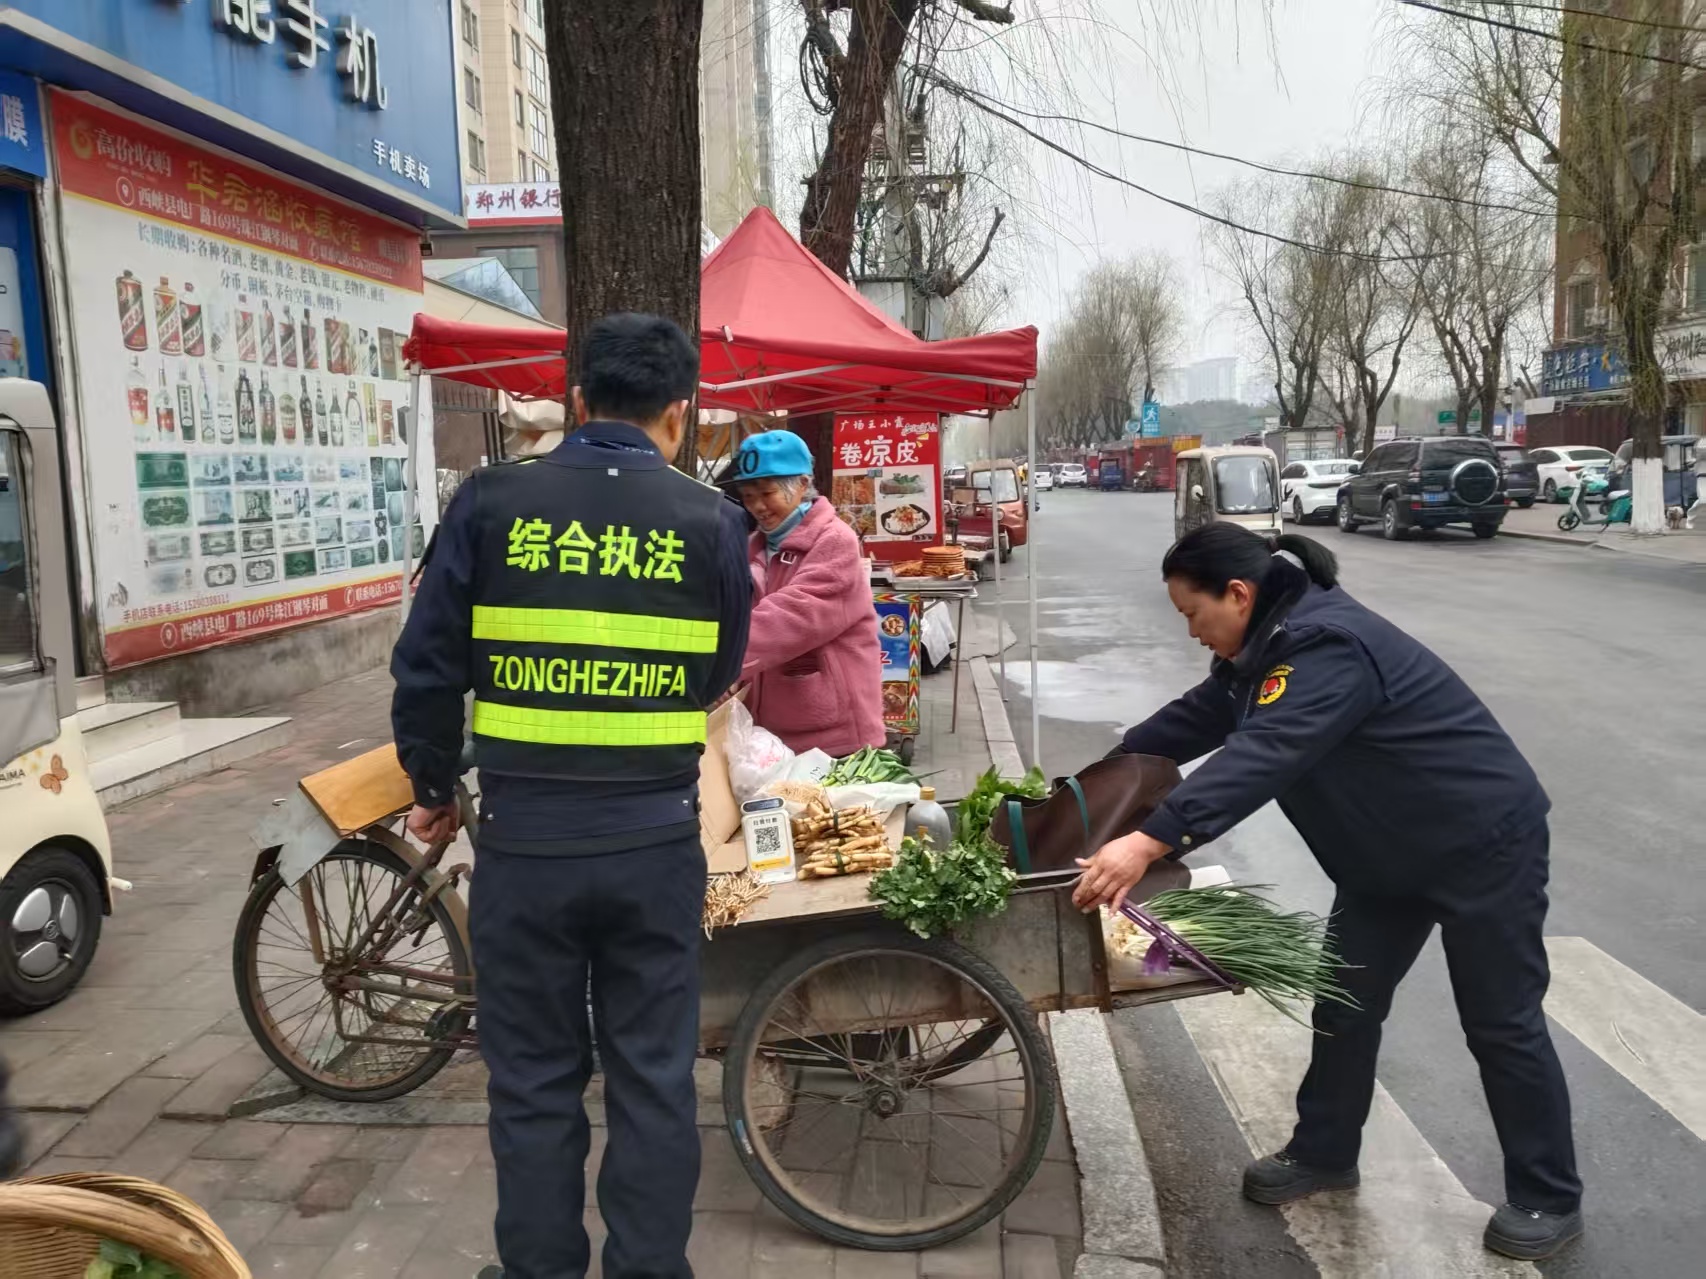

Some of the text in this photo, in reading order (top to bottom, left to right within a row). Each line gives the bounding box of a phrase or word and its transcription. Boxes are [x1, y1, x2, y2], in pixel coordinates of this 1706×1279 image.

[95, 128, 172, 177] 高价收购
[372, 138, 430, 189] 手机卖场
[475, 187, 561, 213] 郑州银行
[839, 435, 919, 467] 卷凉皮
[505, 516, 686, 584] 综合执法
[488, 655, 686, 697] ZONGHEZHIFA
